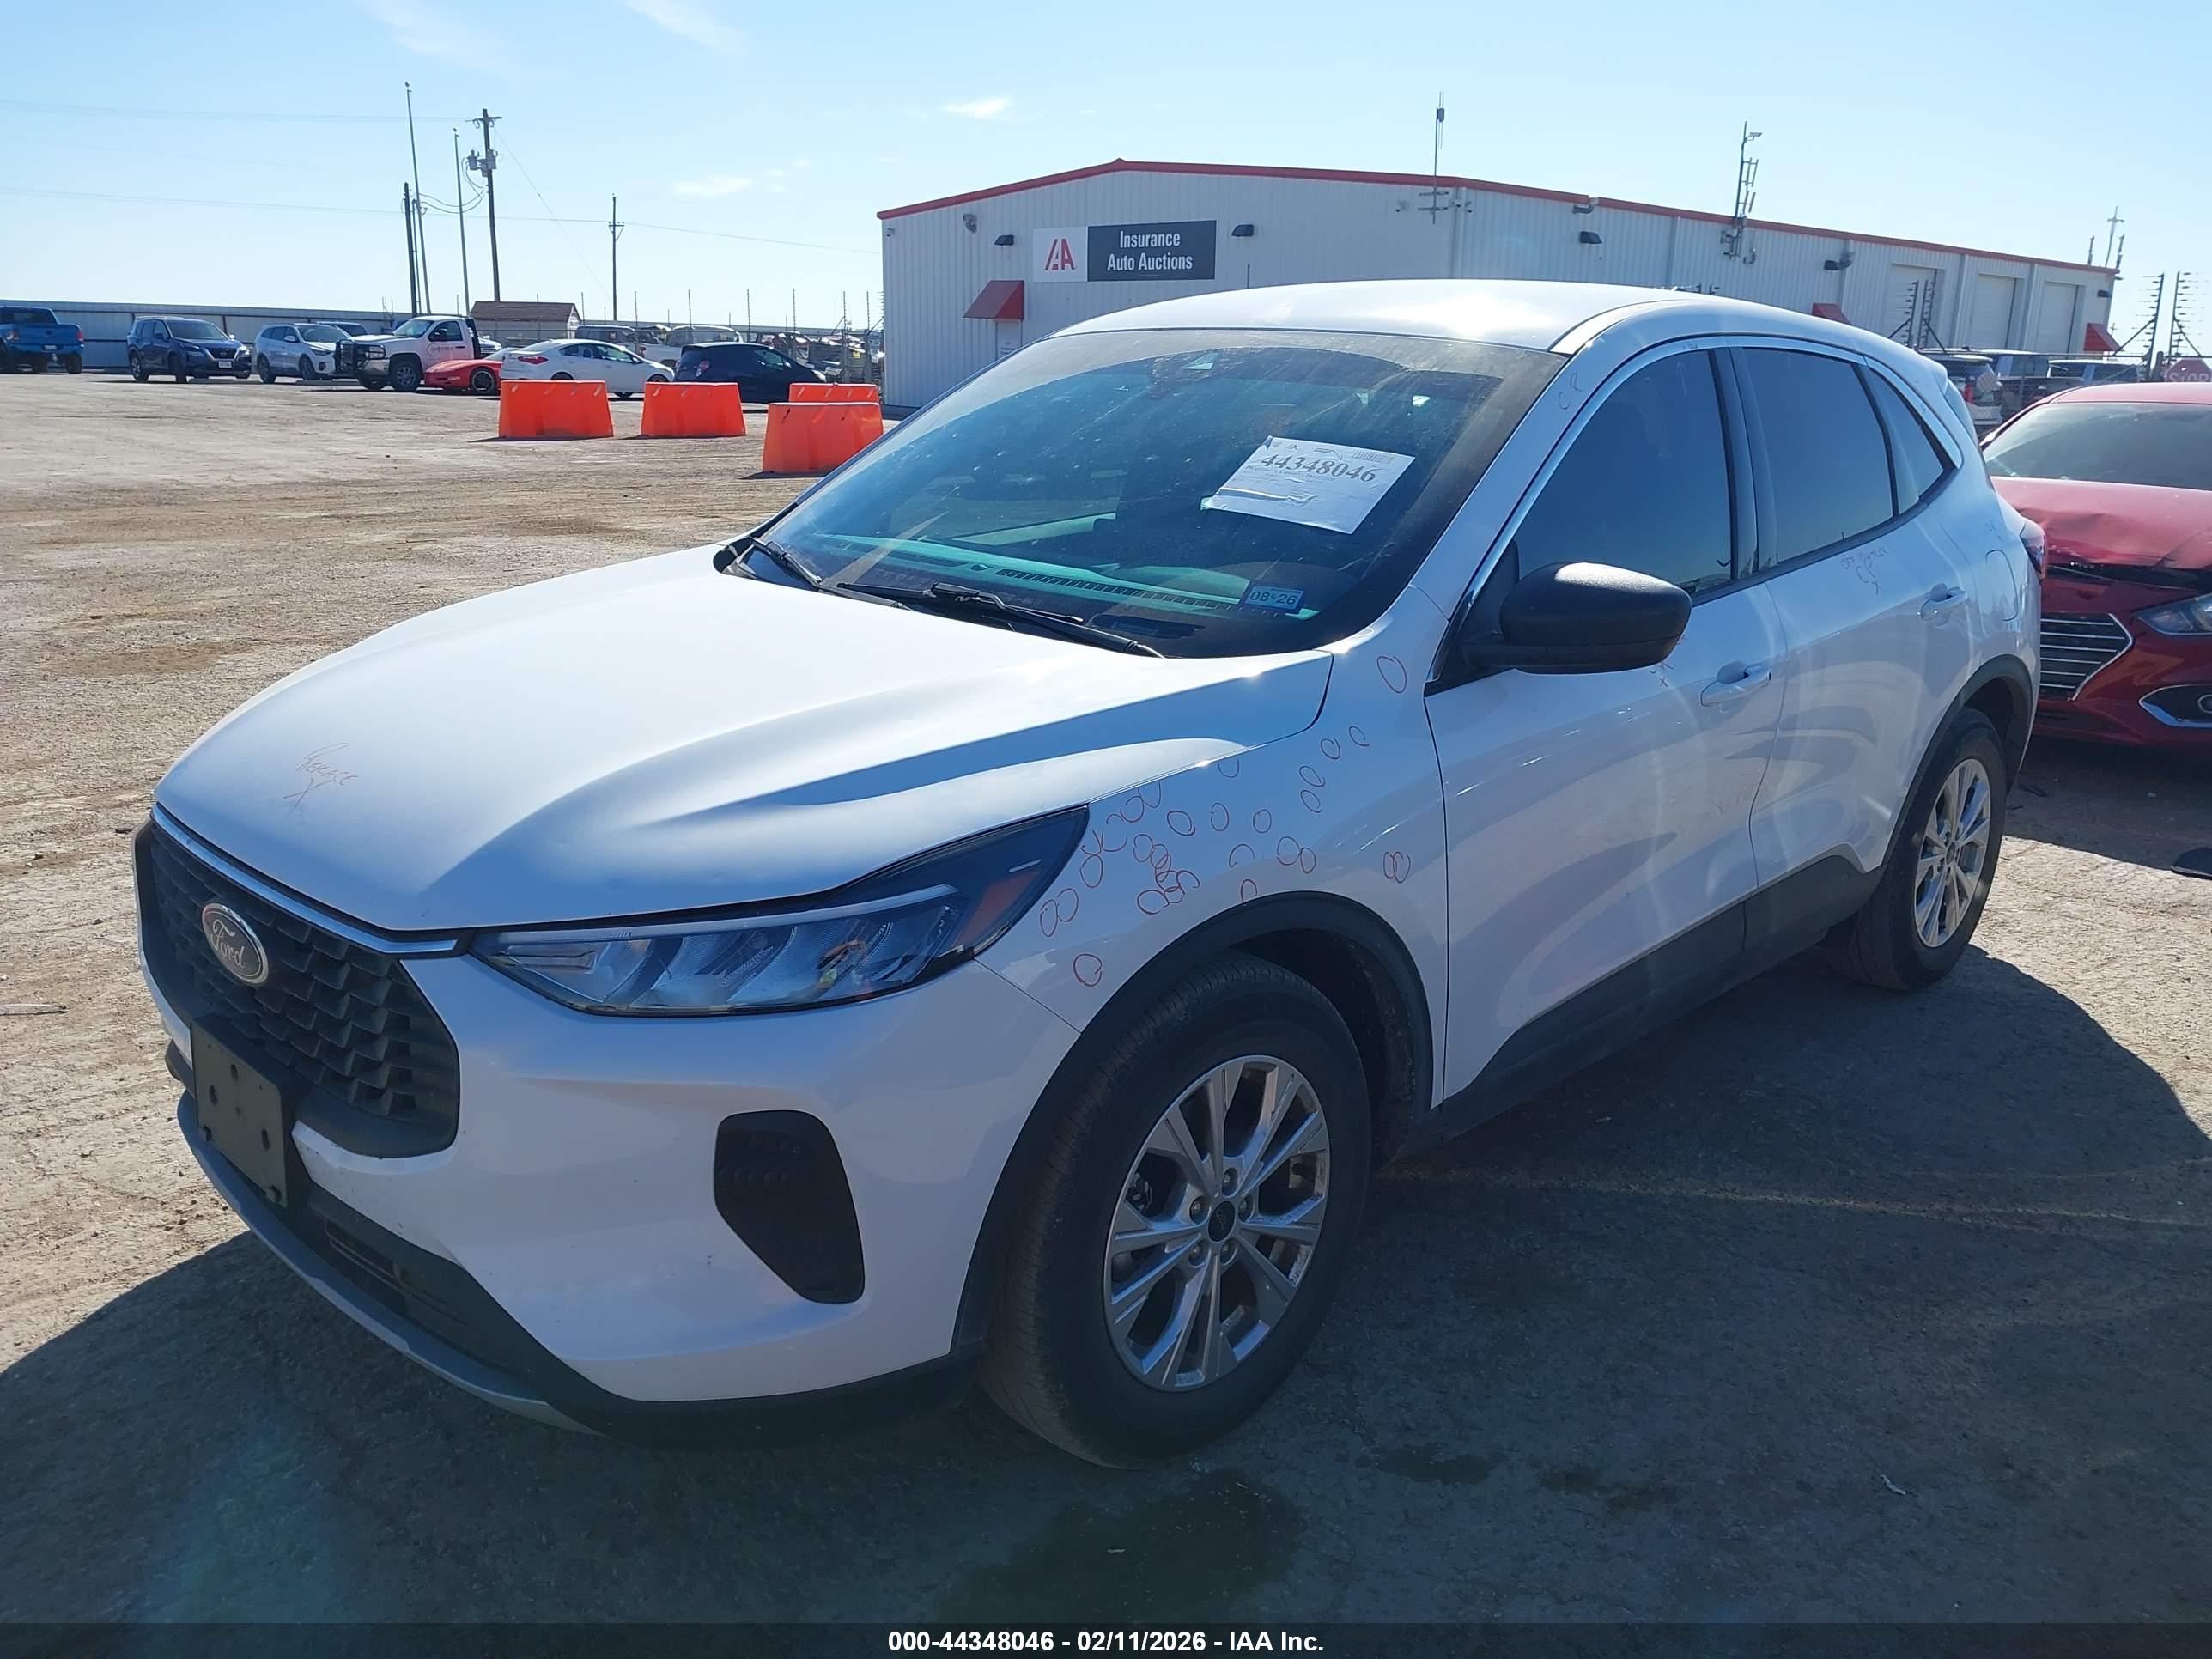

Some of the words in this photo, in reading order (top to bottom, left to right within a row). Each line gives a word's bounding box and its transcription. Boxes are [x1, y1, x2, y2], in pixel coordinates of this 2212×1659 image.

[1119, 230, 1181, 249] Insurance
[1107, 253, 1134, 271] Auto
[1138, 252, 1193, 271] Auctions
[1261, 453, 1380, 483] 44348046
[210, 919, 246, 969] Ford
